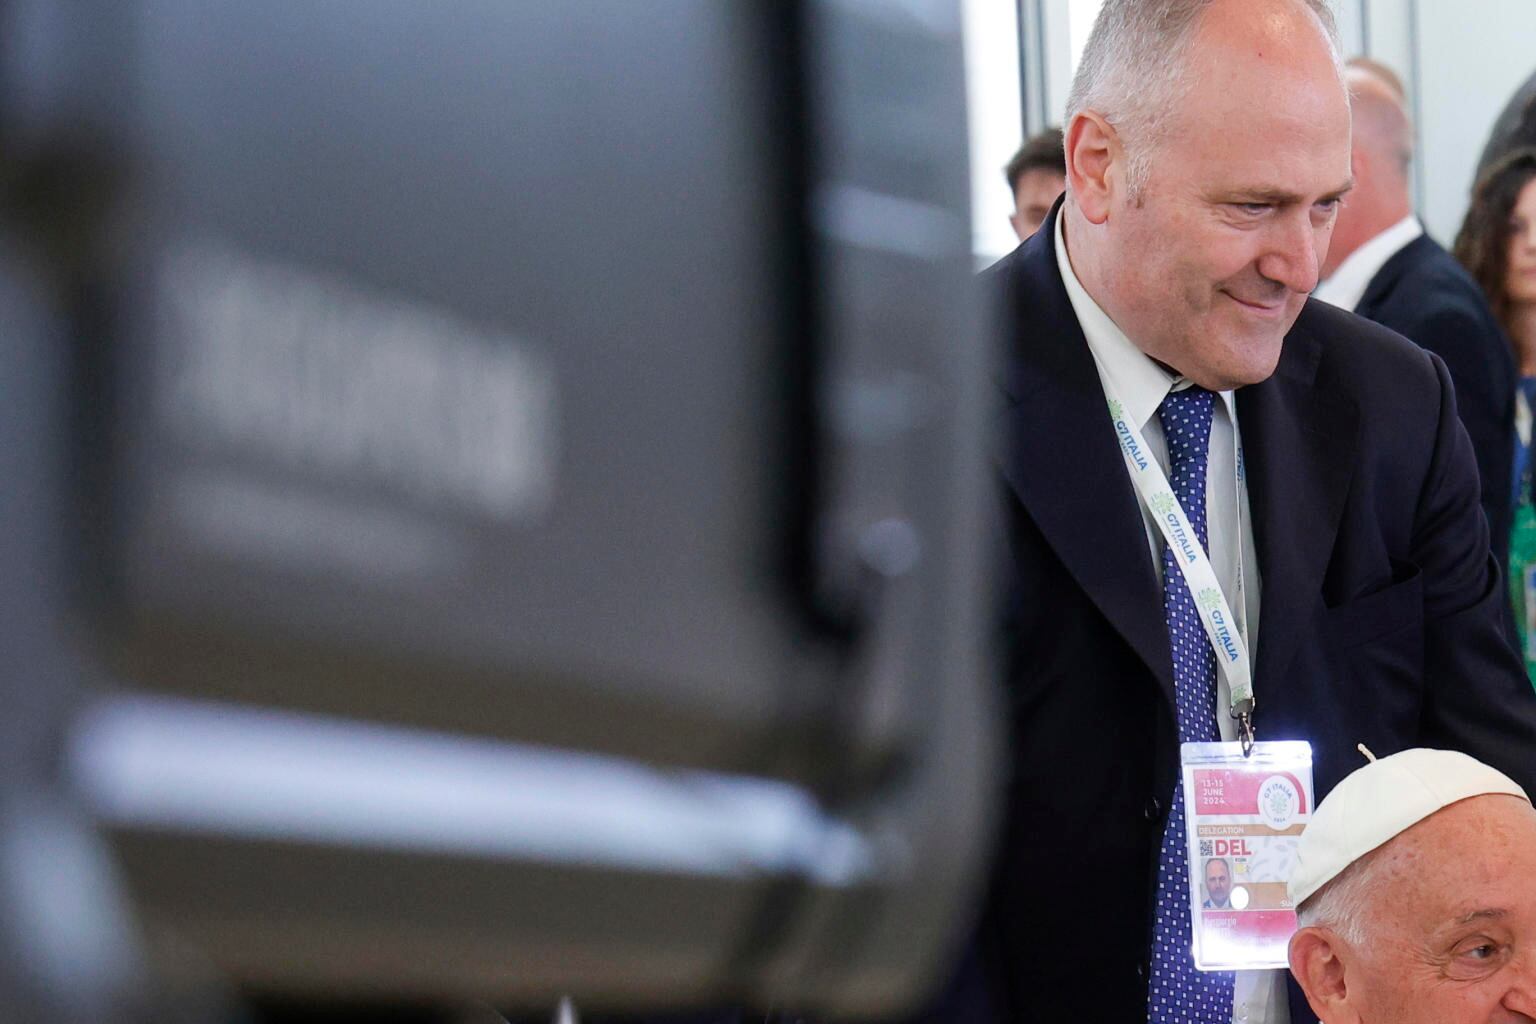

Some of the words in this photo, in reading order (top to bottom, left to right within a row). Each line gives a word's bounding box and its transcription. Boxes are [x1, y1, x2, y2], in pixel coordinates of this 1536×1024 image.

[1116, 420, 1130, 434] G7
[1124, 435, 1148, 471] ITALIA
[1167, 513, 1180, 527] G7
[1174, 528, 1197, 563] ITALIA
[1212, 609, 1225, 624] G7
[1217, 626, 1239, 662] ITALIA
[1203, 788, 1224, 796] JUNE
[1272, 783, 1293, 800] ITALIA
[1204, 797, 1225, 805] 2024
[1199, 826, 1245, 835] DELEGATION
[1215, 839, 1252, 856] DEL
